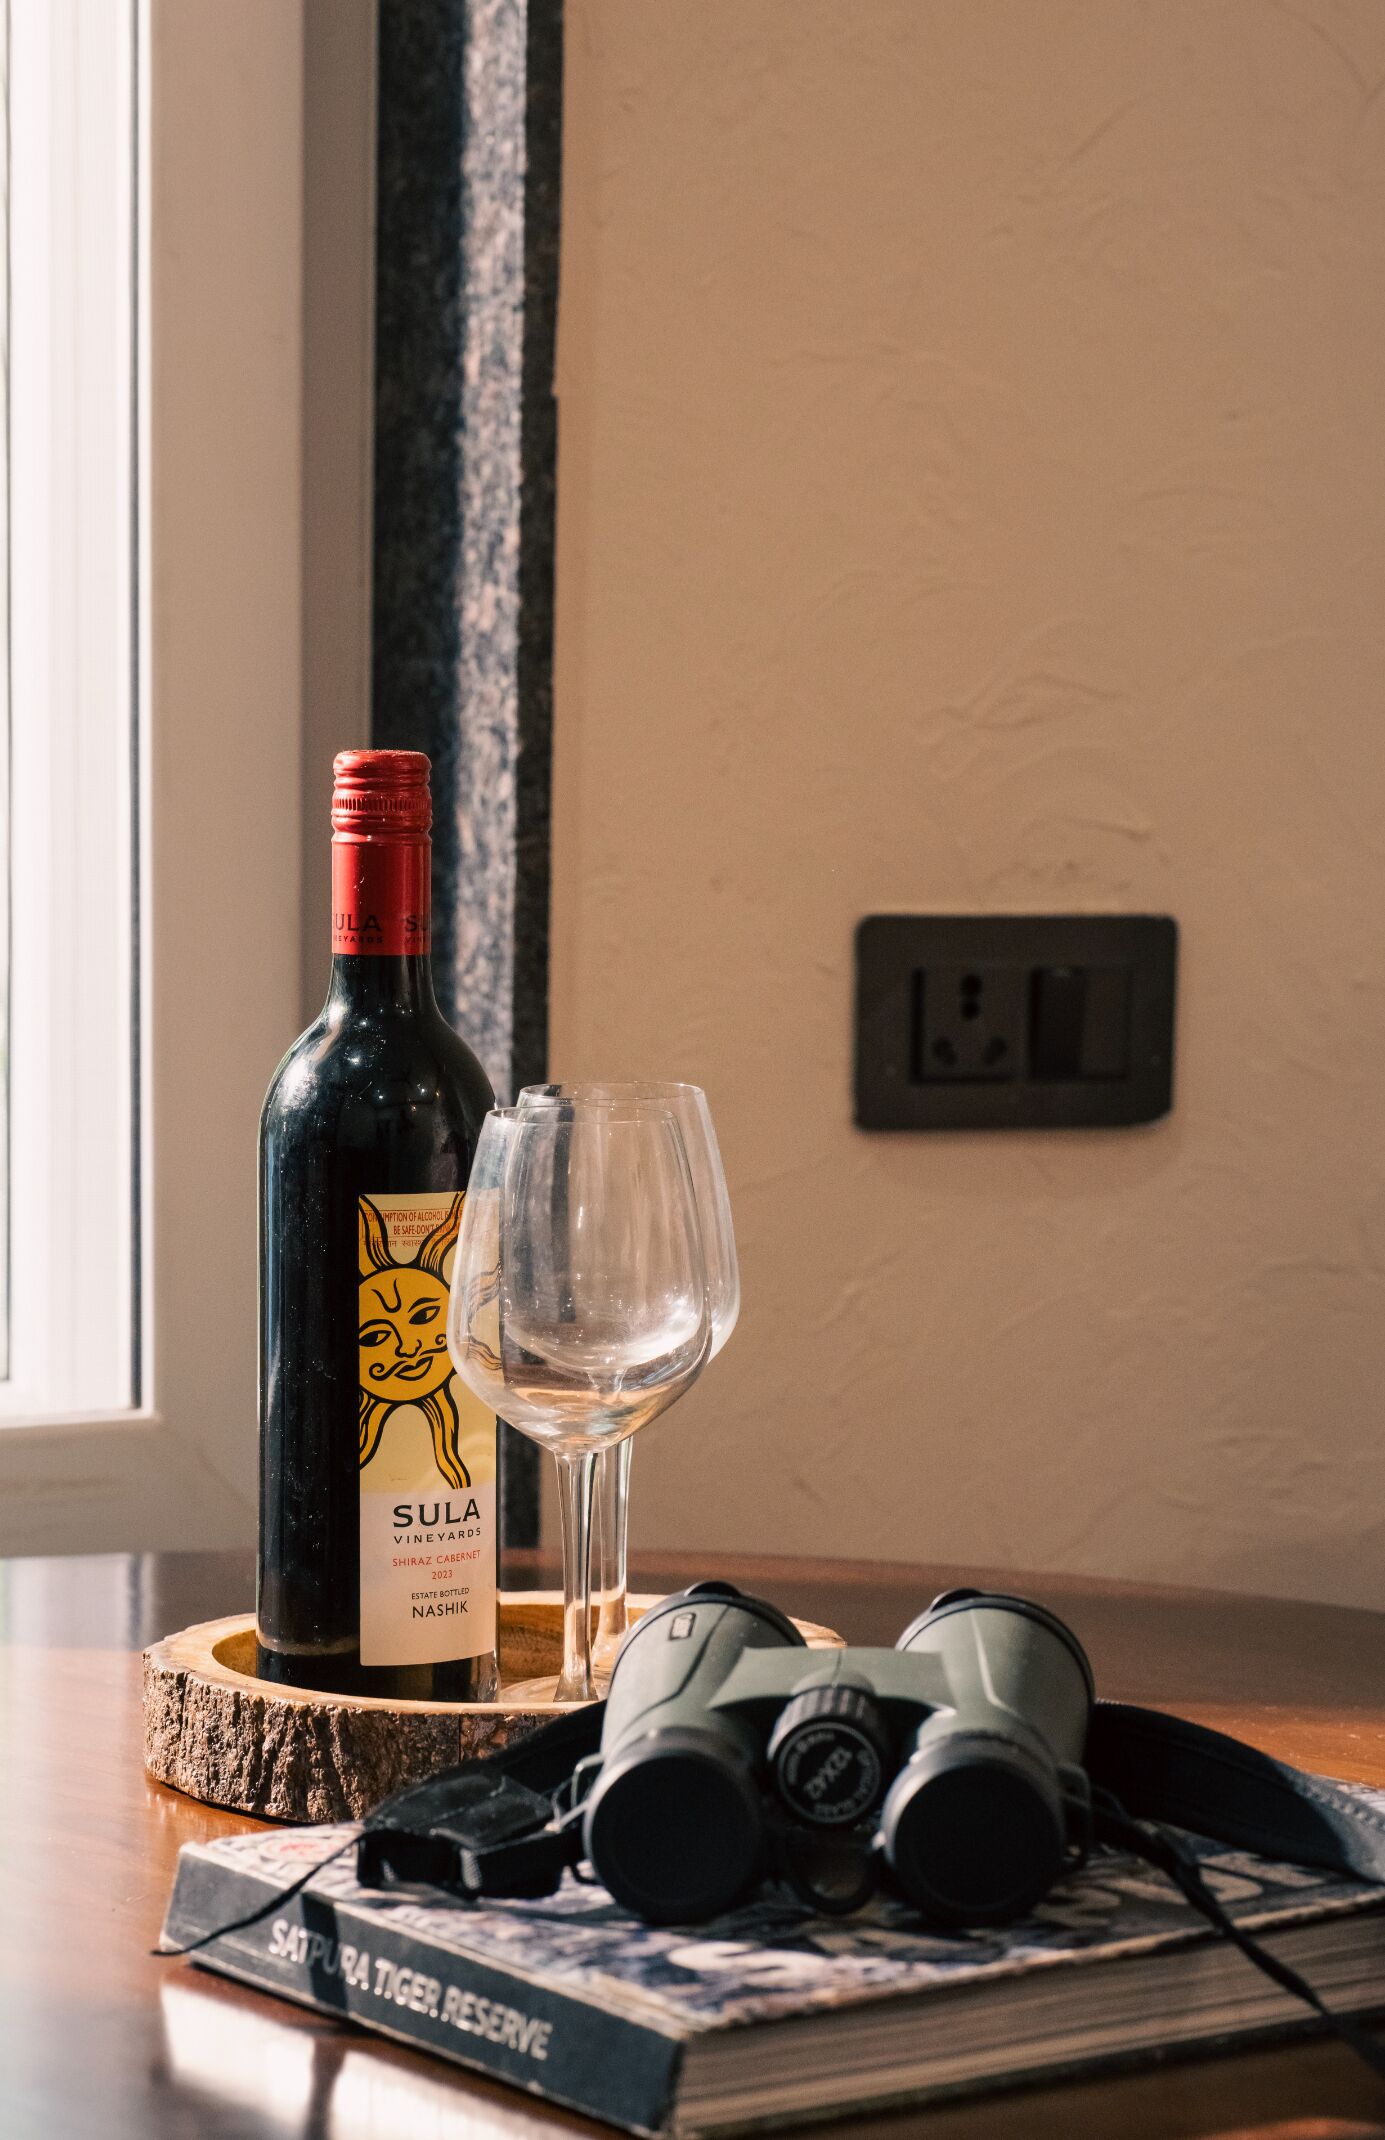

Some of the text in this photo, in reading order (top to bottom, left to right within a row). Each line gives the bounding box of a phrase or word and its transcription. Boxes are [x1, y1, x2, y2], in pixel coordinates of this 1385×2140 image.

[335, 913, 382, 932] ULA
[409, 1212, 417, 1222] OF
[418, 1211, 443, 1222] ALCOHOL
[394, 1225, 401, 1235] BE
[392, 1498, 481, 1528] SULA
[393, 1527, 481, 1544] VINEYARDS
[392, 1549, 481, 1567] SHIRAZ CABERNET
[431, 1569, 453, 1580] 2023
[411, 1587, 470, 1600] ESTATE BOTTLED
[412, 1600, 468, 1619] NASHIK
[268, 1919, 554, 2061] SATPURA TIGER RESERVE
